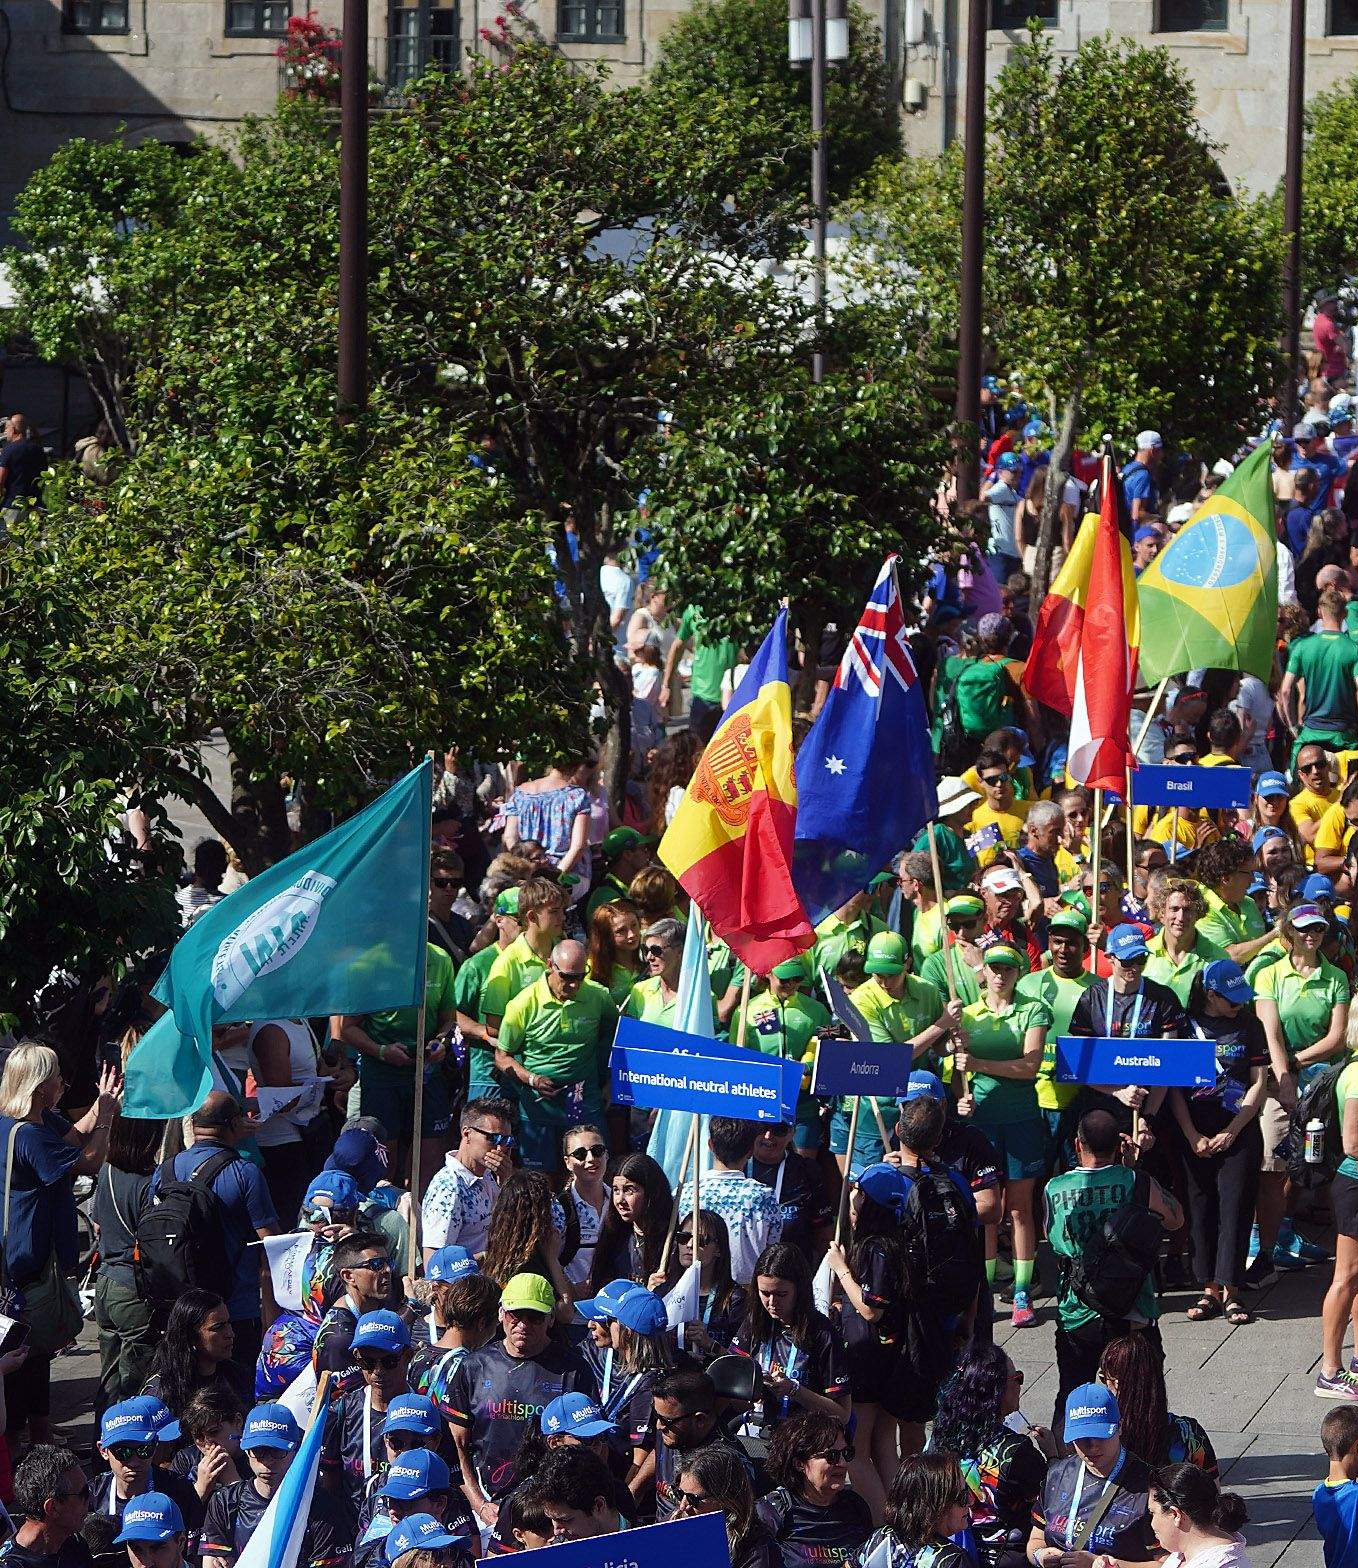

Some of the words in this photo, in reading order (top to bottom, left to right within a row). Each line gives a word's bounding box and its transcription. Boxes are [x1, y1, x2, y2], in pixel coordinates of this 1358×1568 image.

[1166, 780, 1193, 791] Brasil
[1114, 1055, 1161, 1067] Australia
[850, 1061, 880, 1075] Andorra
[619, 1069, 688, 1090] International
[689, 1079, 730, 1095] neutral
[731, 1082, 778, 1100] athletes
[1051, 1184, 1127, 1215] PHOTO
[360, 1322, 396, 1335] Multisport
[390, 1407, 428, 1420] Multisport
[487, 1399, 544, 1419] ultispo
[1070, 1406, 1107, 1419] Multisport
[105, 1414, 144, 1431] Multisport
[250, 1420, 288, 1433] Multisport
[125, 1510, 163, 1523] Multisport
